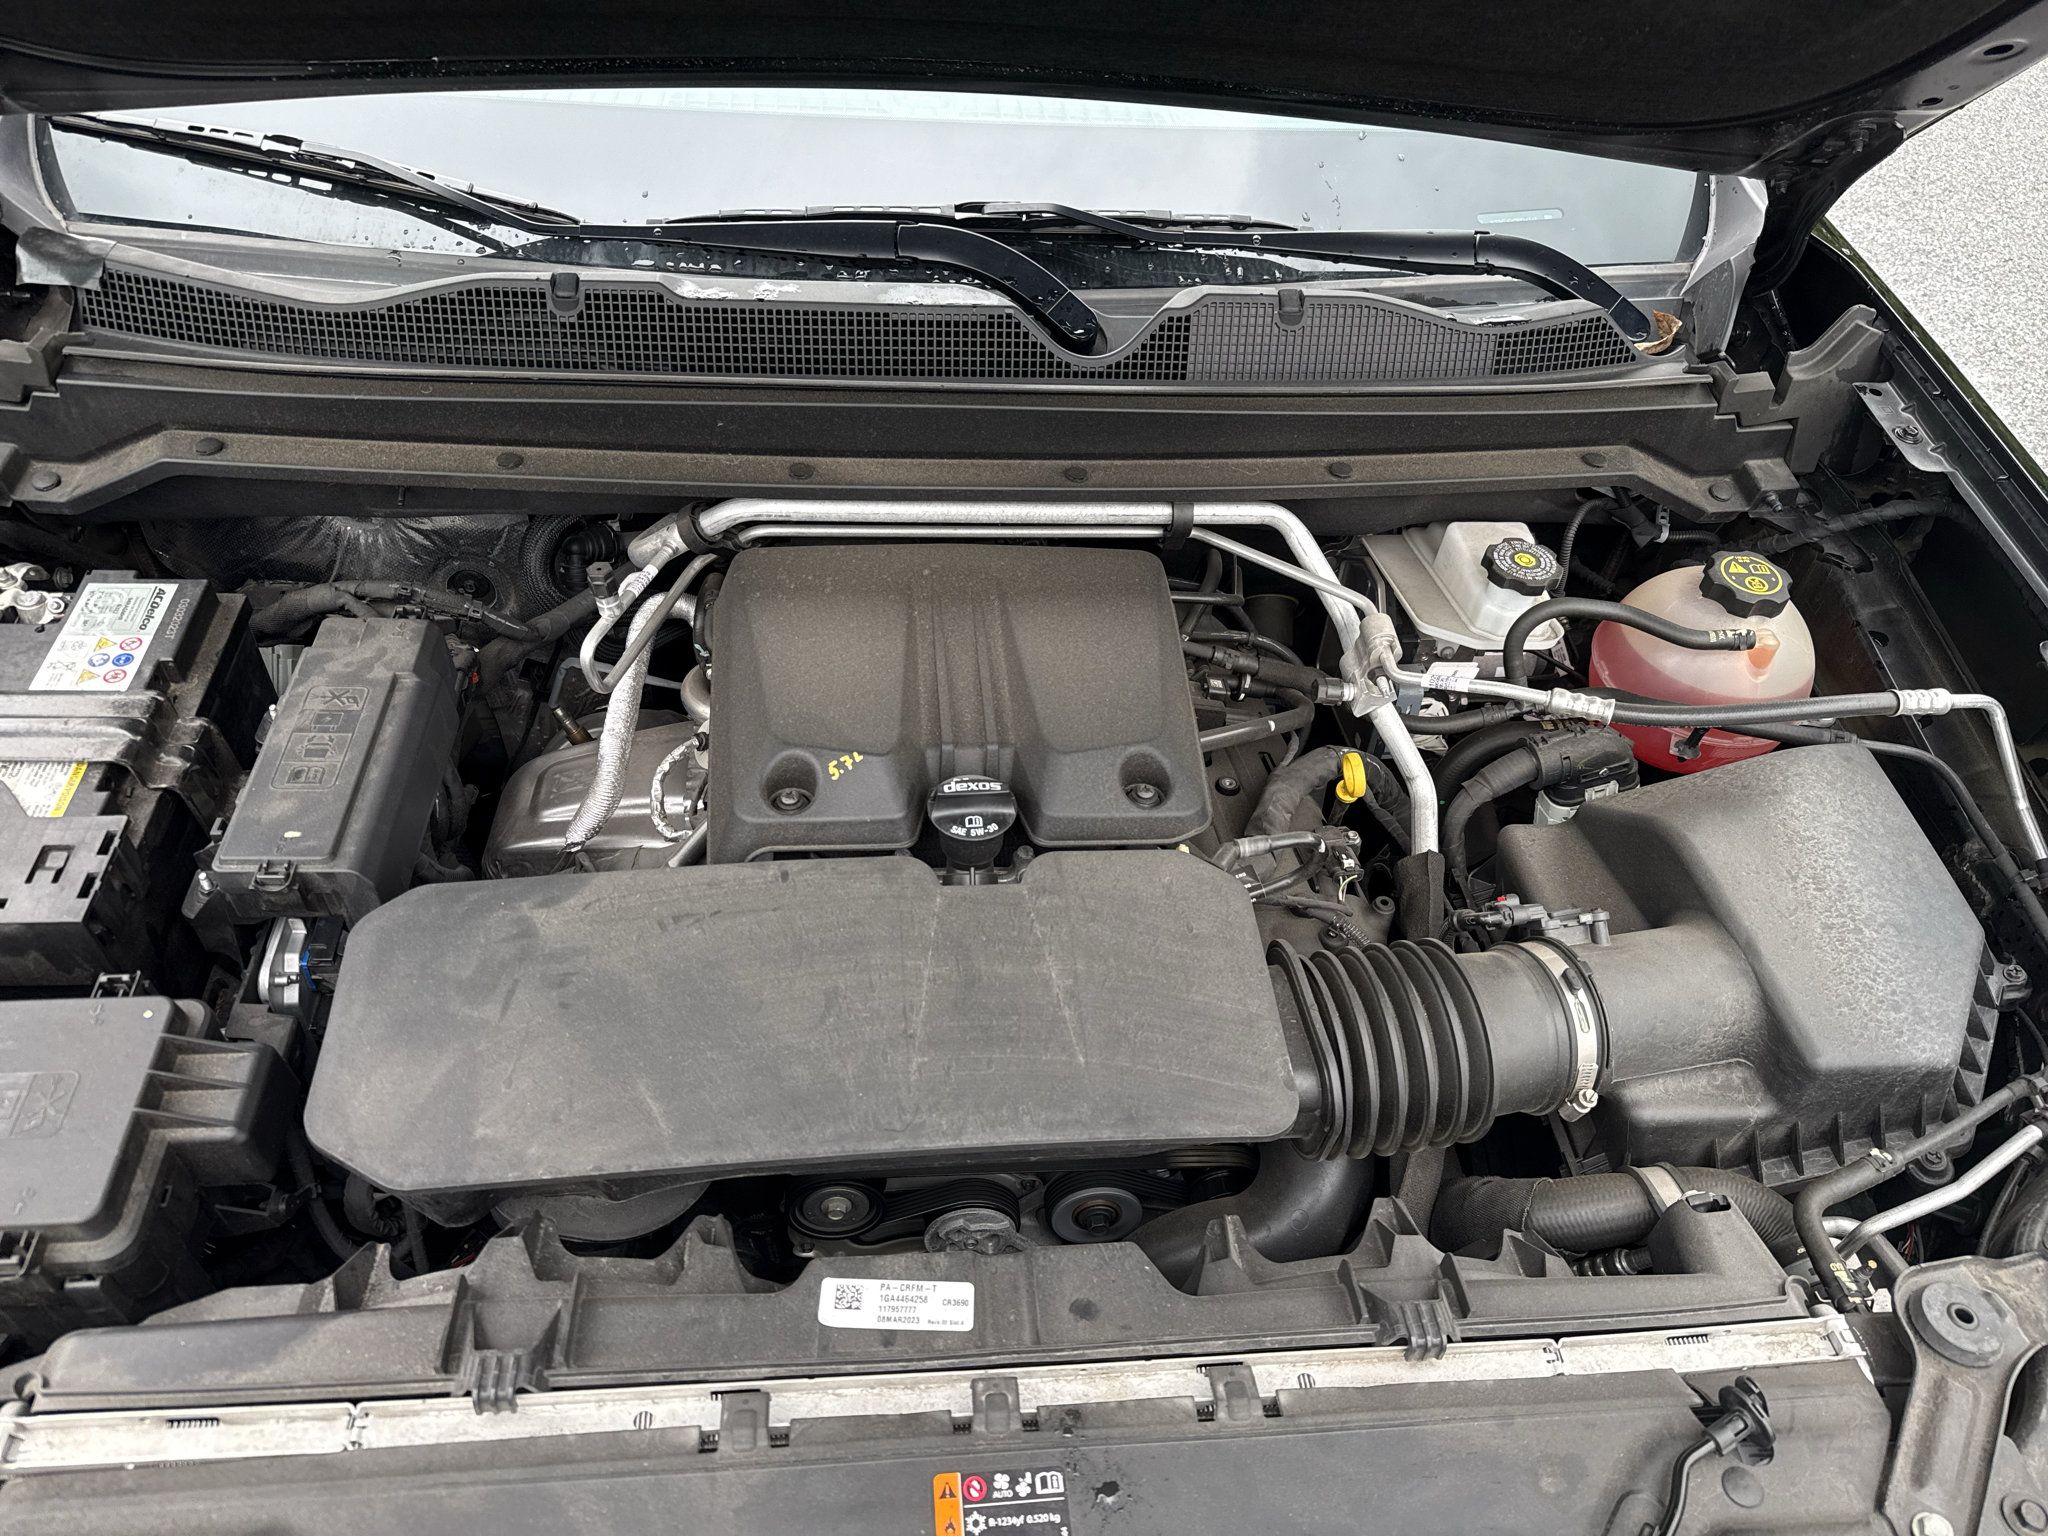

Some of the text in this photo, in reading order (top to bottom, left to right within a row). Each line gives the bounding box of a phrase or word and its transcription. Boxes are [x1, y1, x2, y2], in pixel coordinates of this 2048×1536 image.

[139, 588, 166, 630] ACDelco
[943, 781, 1003, 793] dexos
[950, 822, 999, 836] SAE 5W-30
[942, 1298, 970, 1307] CR3690
[877, 1315, 921, 1325] 08MAR2023
[992, 1489, 1014, 1499] AUTO
[988, 1514, 1025, 1528] R-1234yf
[1049, 1512, 1061, 1524] kg
